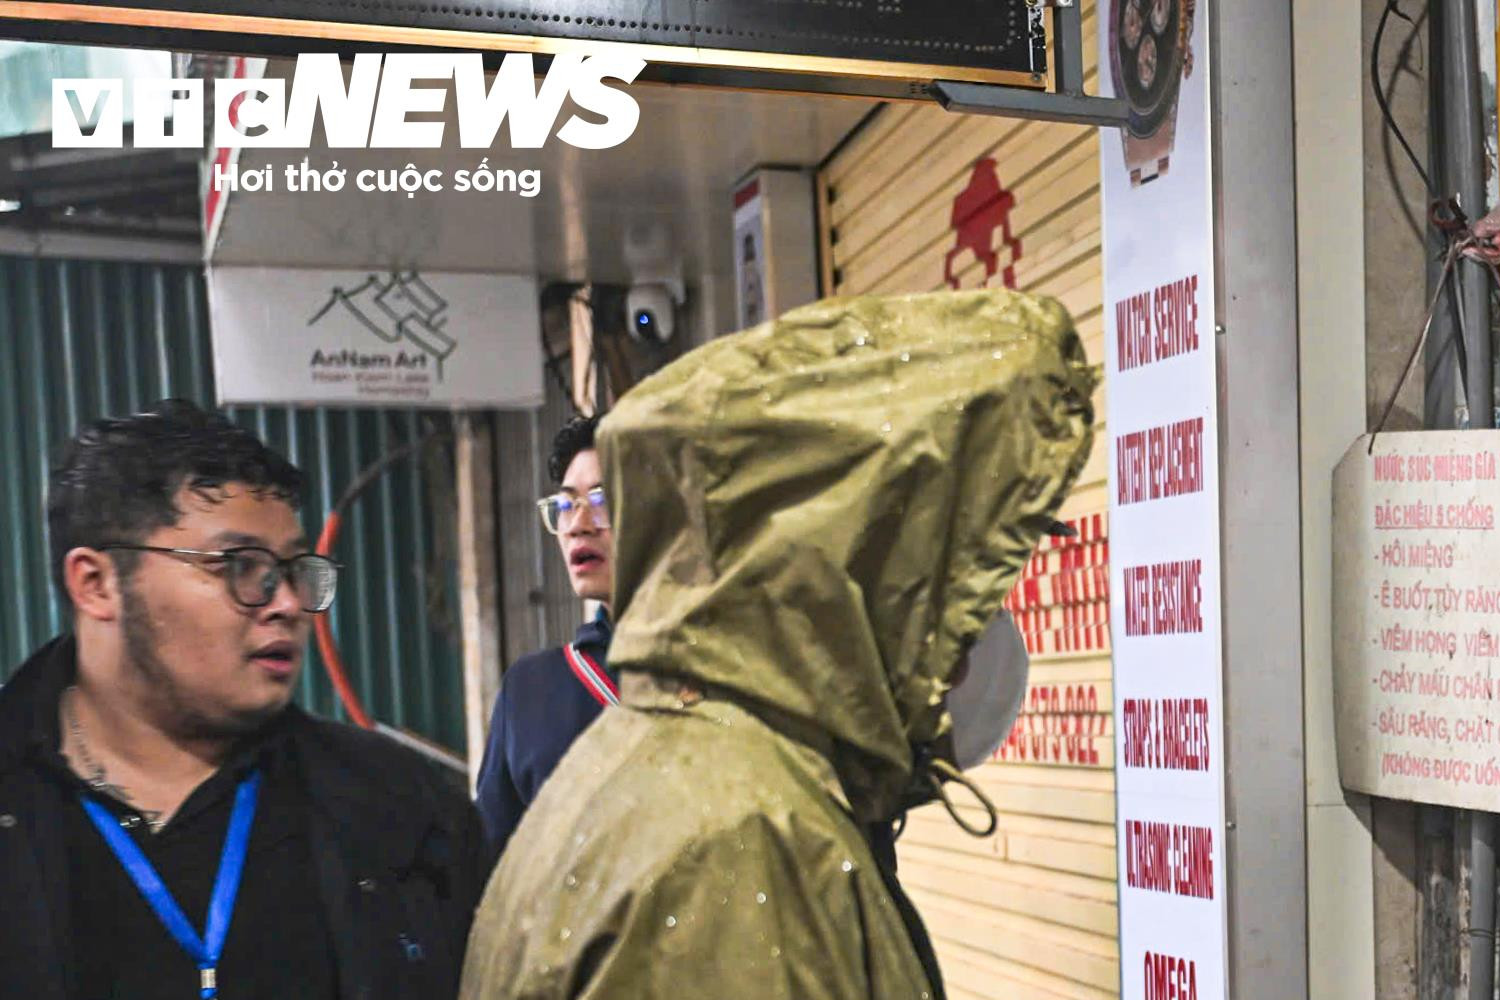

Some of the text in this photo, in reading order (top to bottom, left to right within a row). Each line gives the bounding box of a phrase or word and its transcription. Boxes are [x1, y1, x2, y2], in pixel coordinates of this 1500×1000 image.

[1116, 275, 1199, 372] WATCH SERVICE
[1149, 417, 1203, 500] REPLACEMENT
[1447, 496, 1494, 527] CHỐNG
[1382, 538, 1405, 567] HÔI
[1408, 539, 1454, 574] MIỆNG
[1123, 565, 1151, 637] WATER
[1151, 559, 1203, 635] RESISTANCE
[1381, 580, 1390, 608] Ê
[1393, 580, 1431, 610] BUỐT
[1380, 623, 1413, 652] VIÊM
[1416, 629, 1457, 658] HỌNG
[1464, 628, 1500, 657] VIÊM
[1453, 672, 1493, 700] CHÂN
[1124, 698, 1152, 769] STRAPS
[1162, 698, 1210, 772] BRACELETS
[1379, 707, 1406, 736] SÂU
[1434, 757, 1472, 787] ĐƯỢC
[1173, 824, 1214, 900] CLEANING
